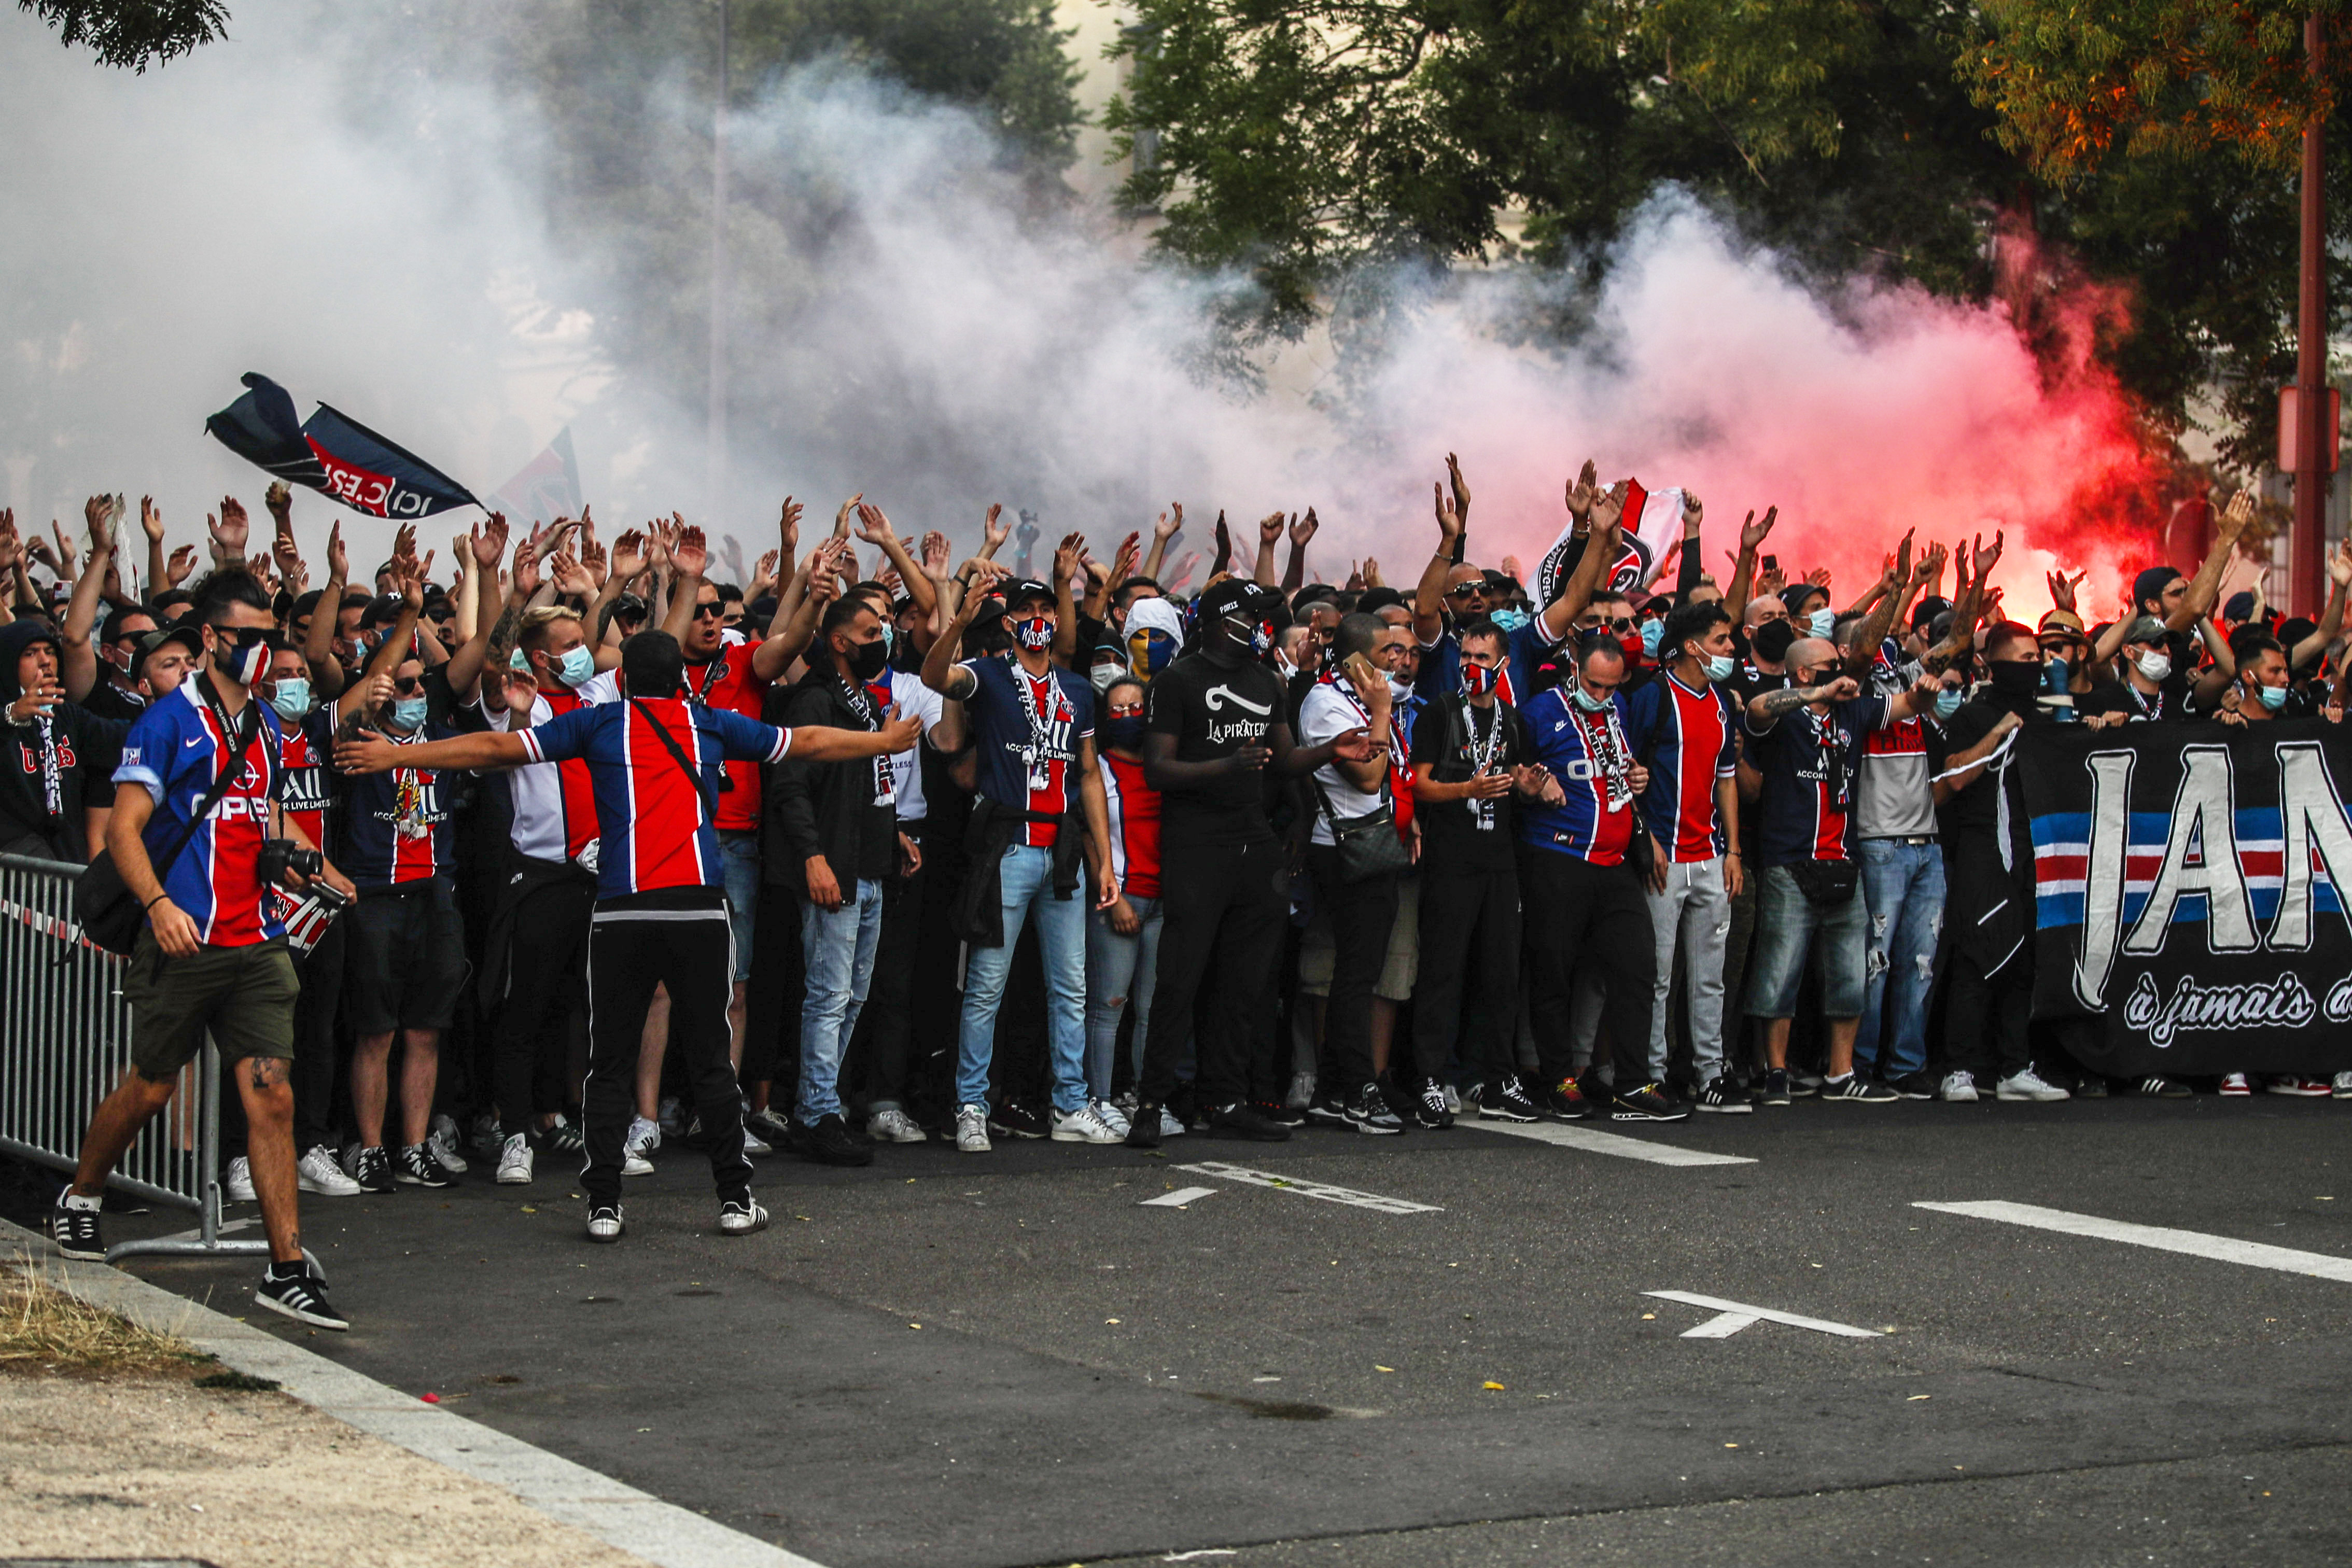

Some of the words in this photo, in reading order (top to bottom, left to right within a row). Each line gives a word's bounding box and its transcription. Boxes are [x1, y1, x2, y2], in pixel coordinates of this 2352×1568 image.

[191, 793, 269, 822] OPE
[291, 801, 309, 810] LIVE
[2151, 974, 2314, 1044] jamais
